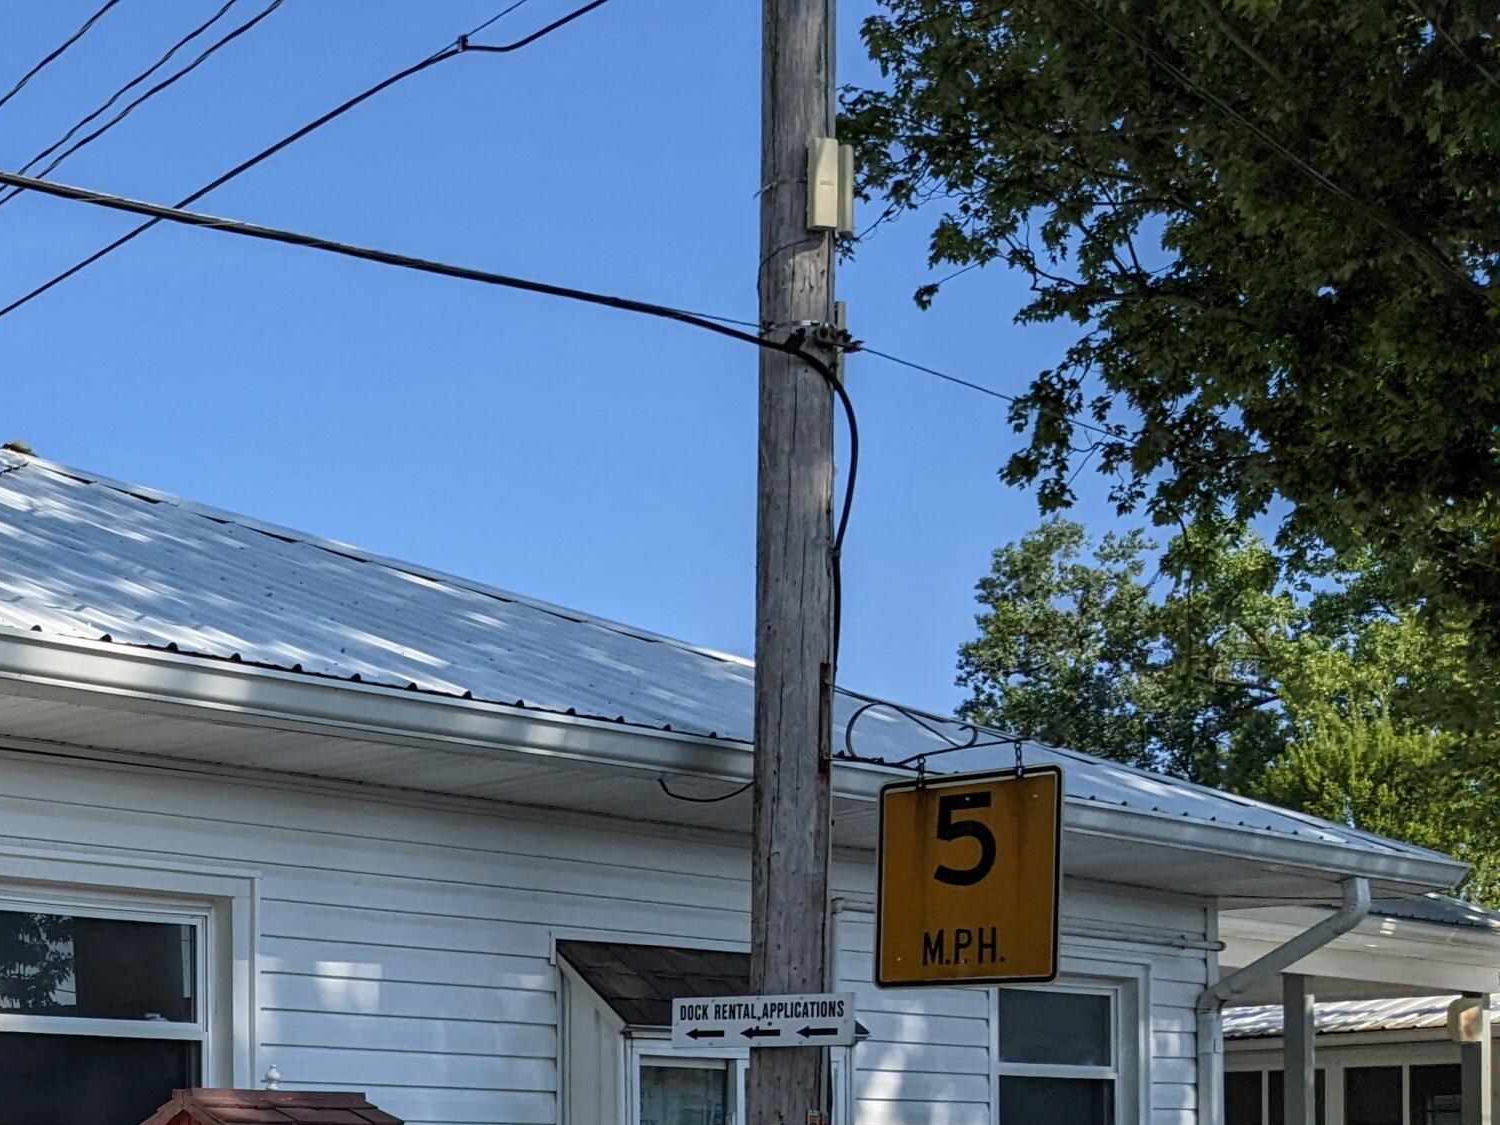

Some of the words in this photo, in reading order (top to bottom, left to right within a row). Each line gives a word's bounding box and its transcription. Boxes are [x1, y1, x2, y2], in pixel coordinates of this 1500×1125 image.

[934, 791, 997, 886] 5
[680, 1005, 709, 1021] DOCK
[714, 1003, 756, 1021] RENTAL
[762, 1000, 844, 1019] APPLICATIONS
